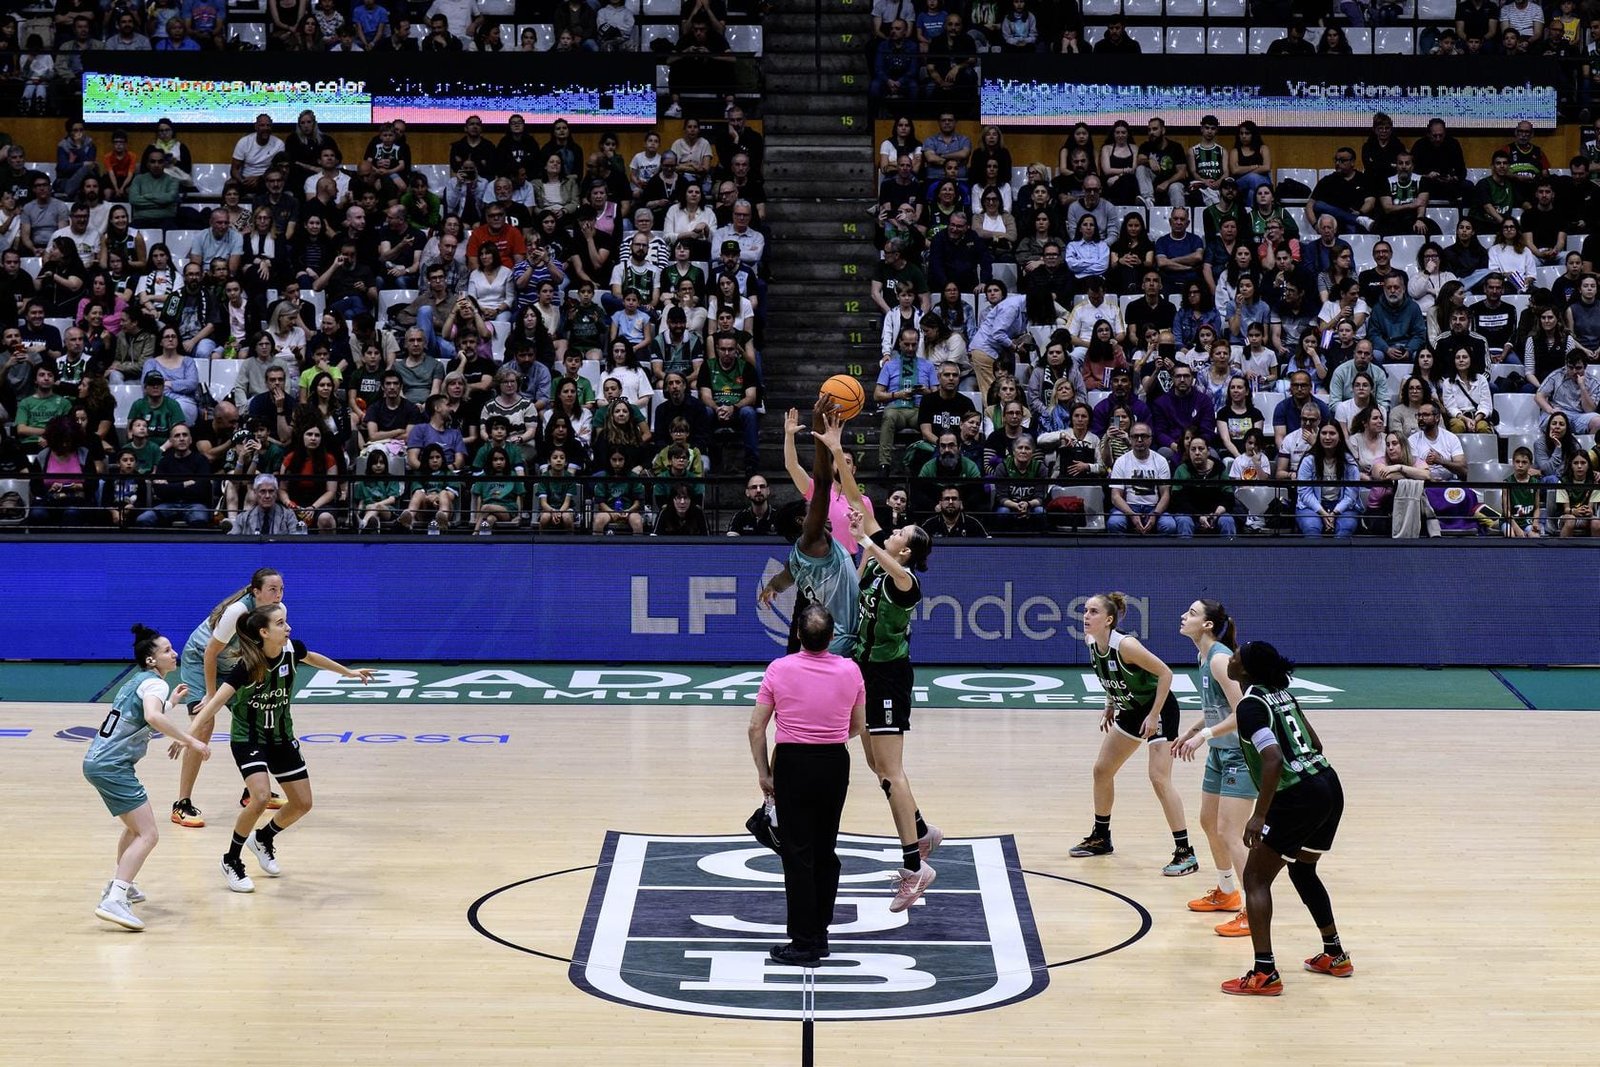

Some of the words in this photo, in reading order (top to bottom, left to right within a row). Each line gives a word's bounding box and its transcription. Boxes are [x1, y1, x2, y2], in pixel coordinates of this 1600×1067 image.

[841, 34, 852, 43] 17
[315, 77, 366, 92] color
[841, 75, 854, 84] 16
[1286, 80, 1348, 98] Viajar
[1407, 85, 1432, 96] un
[841, 116, 853, 126] 15
[842, 224, 856, 233] 14
[843, 265, 857, 274] 13
[845, 302, 859, 312] 12
[849, 333, 862, 343] 11
[848, 365, 863, 376] 10
[857, 433, 866, 444] 8
[857, 451, 865, 462] 7
[631, 576, 737, 634] LF
[295, 688, 513, 700] Palau
[100, 709, 121, 738] 0
[264, 710, 275, 729] 11
[1286, 714, 1311, 755] 2
[679, 950, 937, 992] B
